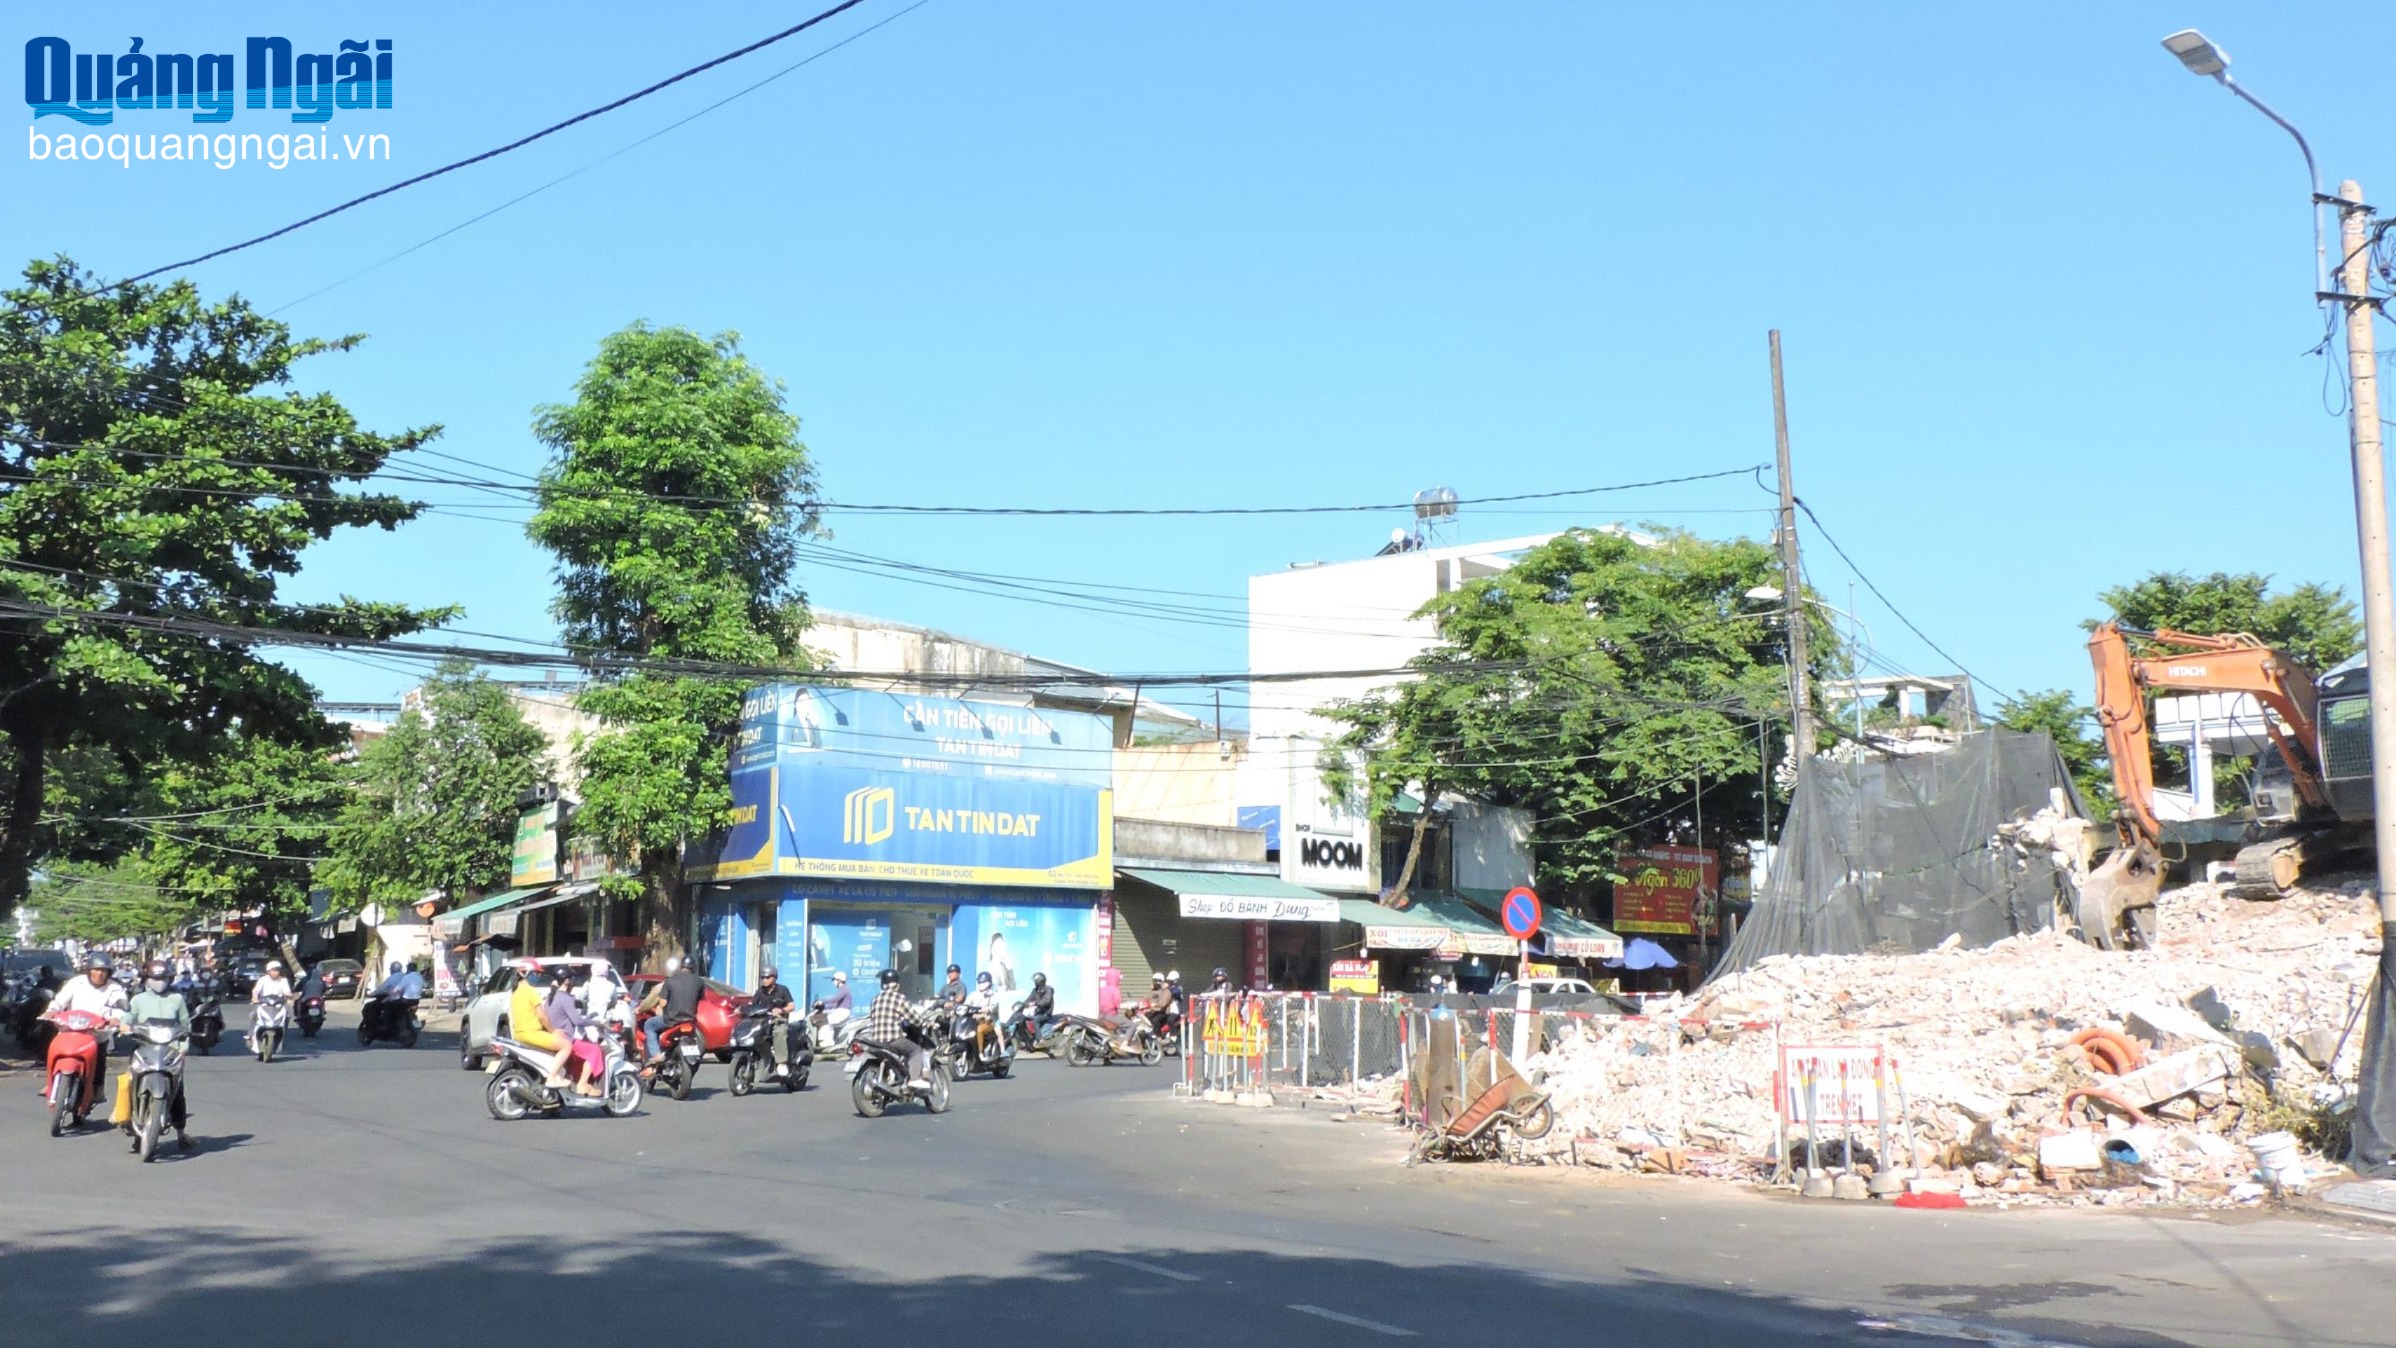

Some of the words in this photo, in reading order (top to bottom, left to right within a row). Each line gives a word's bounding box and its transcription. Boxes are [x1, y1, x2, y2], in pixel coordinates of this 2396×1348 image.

[2168, 666, 2207, 677] HITACHI
[985, 712, 1015, 737] GỌI
[1301, 838, 1363, 872] MOOM
[838, 864, 857, 874] MUA
[919, 867, 930, 877] XE
[1188, 898, 1213, 915] Shop
